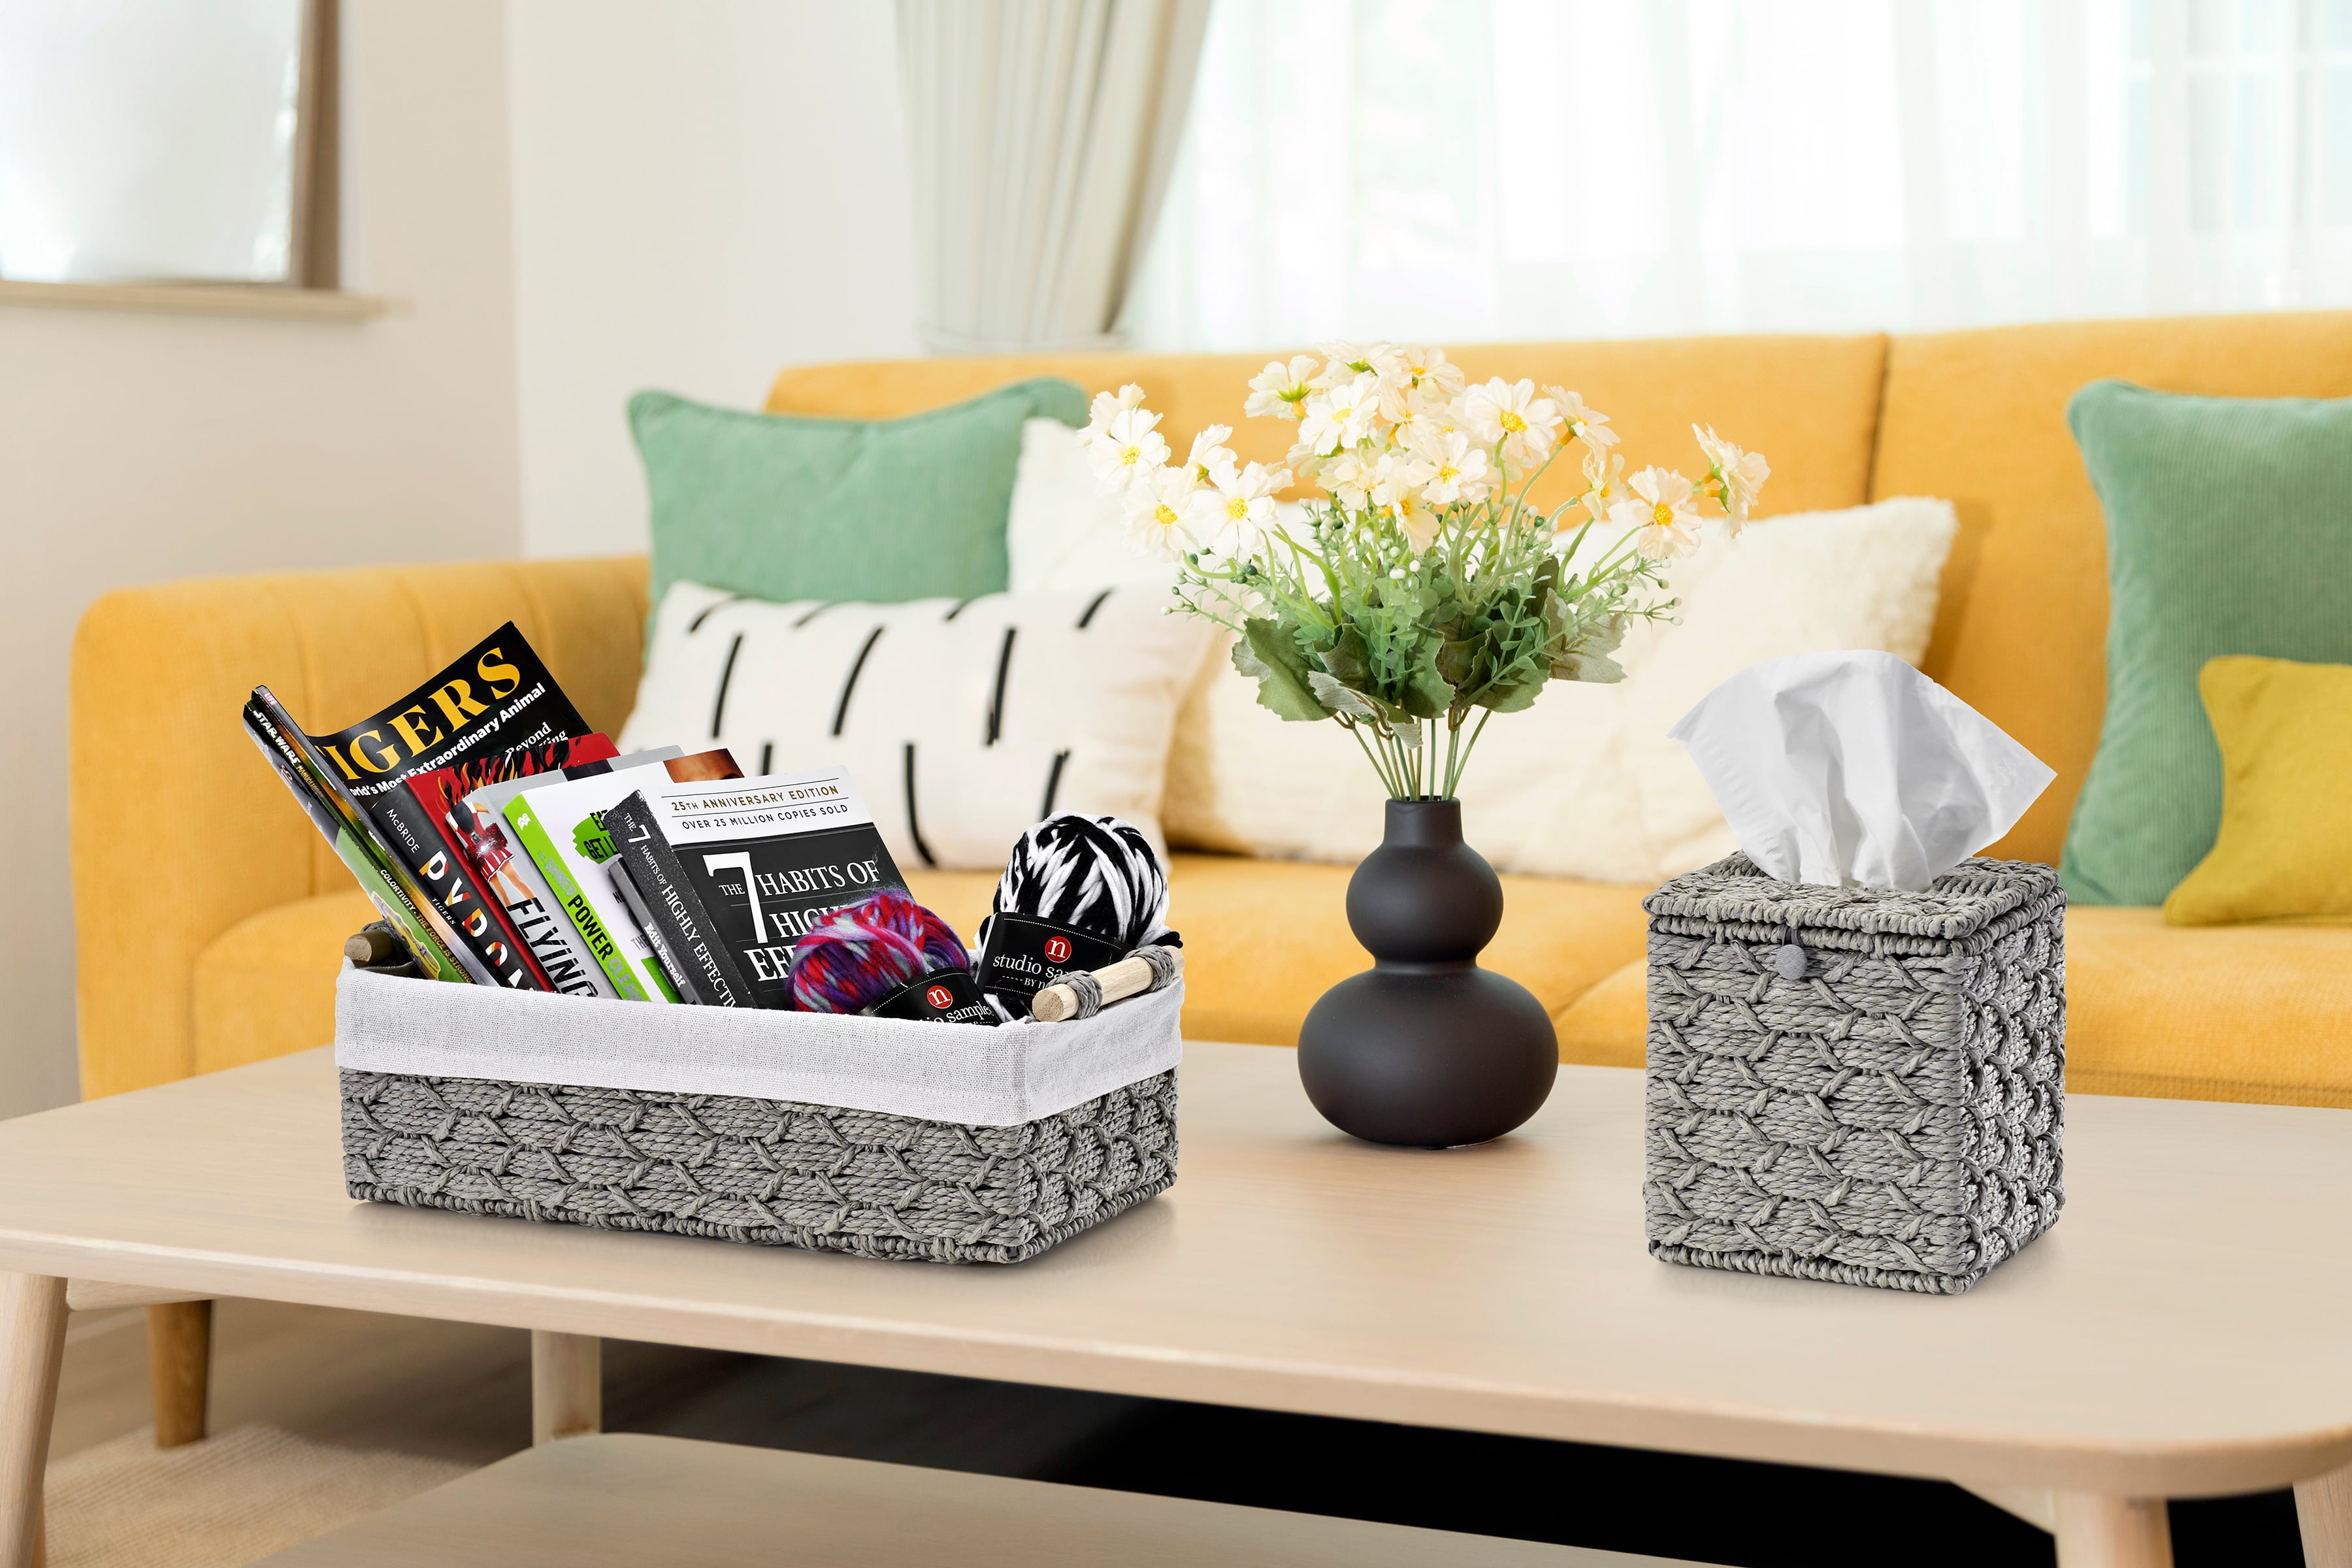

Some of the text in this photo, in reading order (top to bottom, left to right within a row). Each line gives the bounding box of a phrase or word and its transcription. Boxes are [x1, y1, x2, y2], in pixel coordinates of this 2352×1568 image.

[264, 693, 277, 706] LIFE
[315, 647, 521, 780] IGERS
[253, 710, 277, 739] STAR
[275, 736, 301, 765] WARS
[350, 783, 379, 797] orld's
[406, 717, 500, 777] Extraordinary
[499, 682, 546, 723] Animal
[672, 785, 839, 811] 25TH ANNIVERSARY EDITION
[387, 808, 420, 854] McBRIDE
[624, 812, 636, 832] THE
[682, 804, 848, 830] OVER 25 MILLION COPIES SOLD
[628, 824, 651, 843] 7
[583, 838, 609, 860] GET
[640, 845, 660, 875] HABITS
[657, 873, 667, 886] OF
[432, 897, 456, 925] TIGERS
[702, 851, 881, 943] THE 7 HABITS OF
[380, 869, 472, 983] COLORTIVITY THE FORCE IS STRONG
[662, 884, 701, 941] HIGHLY
[769, 905, 847, 938] HIG
[544, 858, 576, 898] SHRED
[567, 894, 614, 961] POWER
[608, 957, 644, 1001] CLEAN
[644, 922, 686, 988] Edit Yourself
[1048, 939, 1066, 958] n
[992, 954, 1042, 975] studio
[1024, 977, 1037, 987] BY
[929, 989, 951, 1005] n
